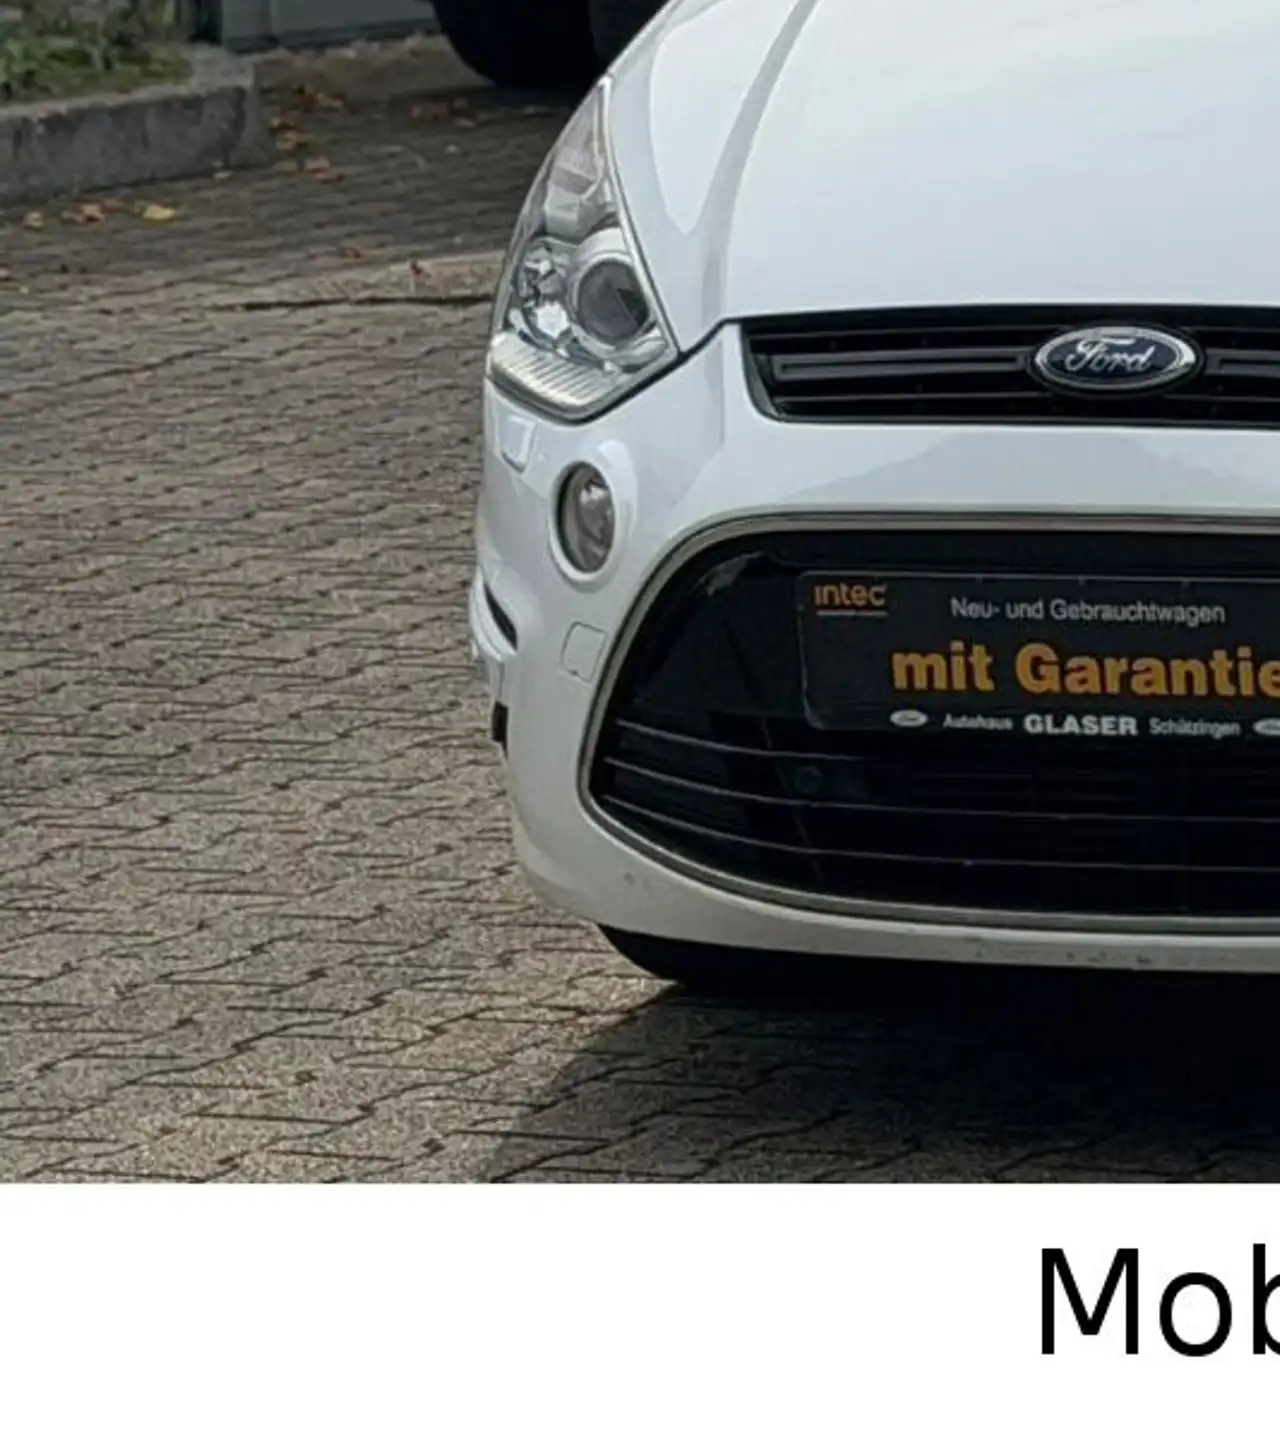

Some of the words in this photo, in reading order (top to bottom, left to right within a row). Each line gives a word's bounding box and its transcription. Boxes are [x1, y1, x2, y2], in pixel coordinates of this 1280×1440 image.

[1064, 337, 1157, 373] Ford
[950, 596, 1000, 619] Neu-
[1005, 598, 1044, 621] und
[1050, 597, 1226, 628] Gebrauchtwagen
[891, 640, 995, 692] mit
[943, 713, 1014, 731] Autohaus
[1024, 713, 1138, 737] GLASER
